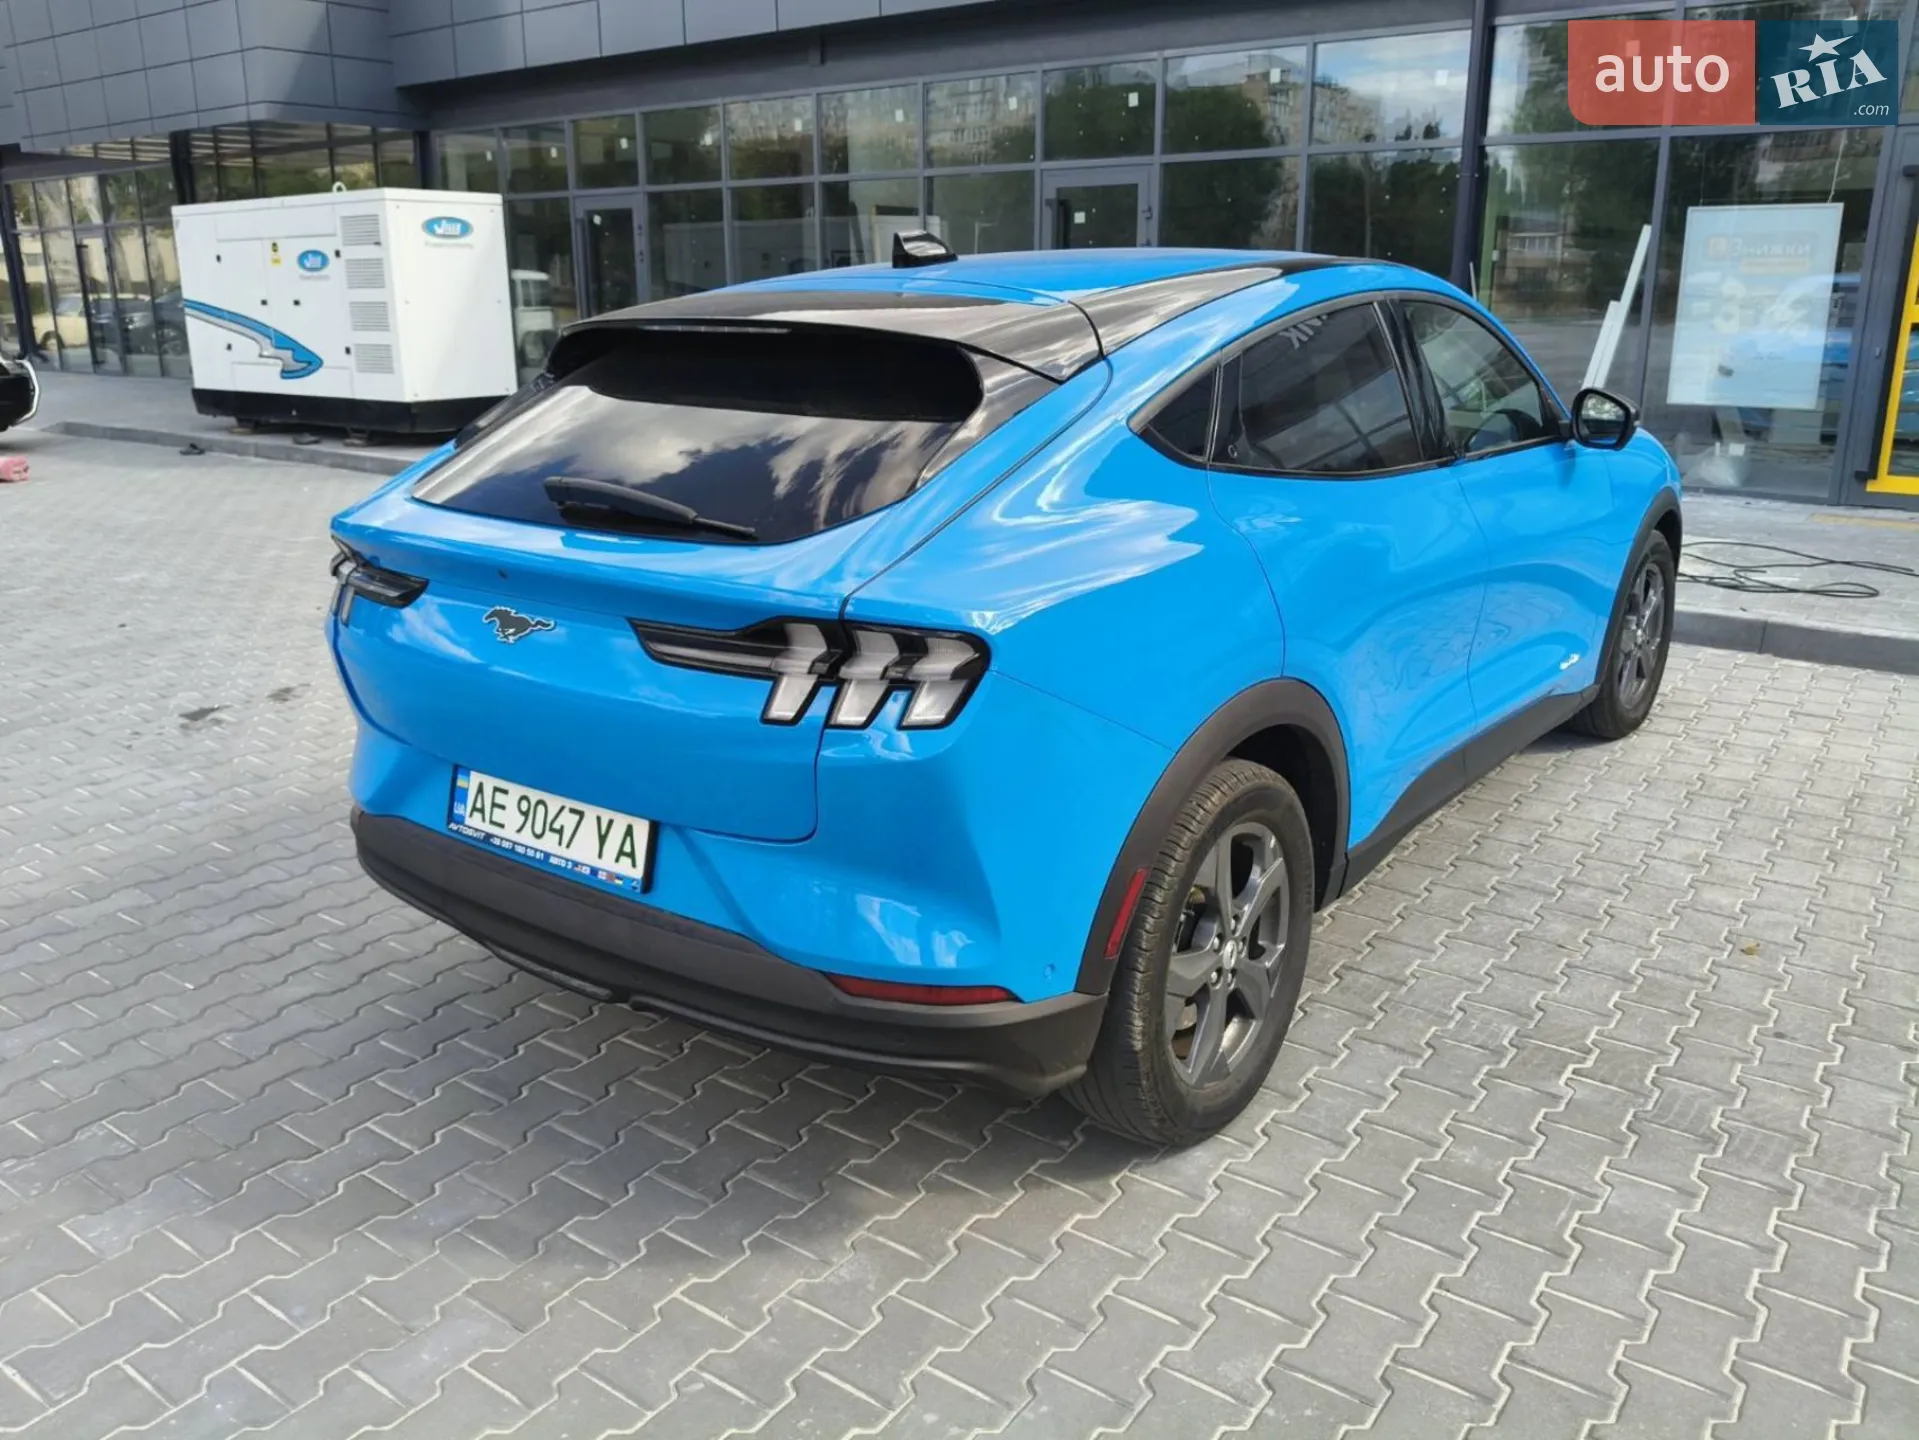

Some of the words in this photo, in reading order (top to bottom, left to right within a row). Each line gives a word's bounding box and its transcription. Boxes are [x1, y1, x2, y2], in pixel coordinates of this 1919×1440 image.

[453, 801, 465, 817] UA
[469, 781, 509, 829] AE
[516, 795, 585, 850] 9047
[596, 814, 637, 869] YA
